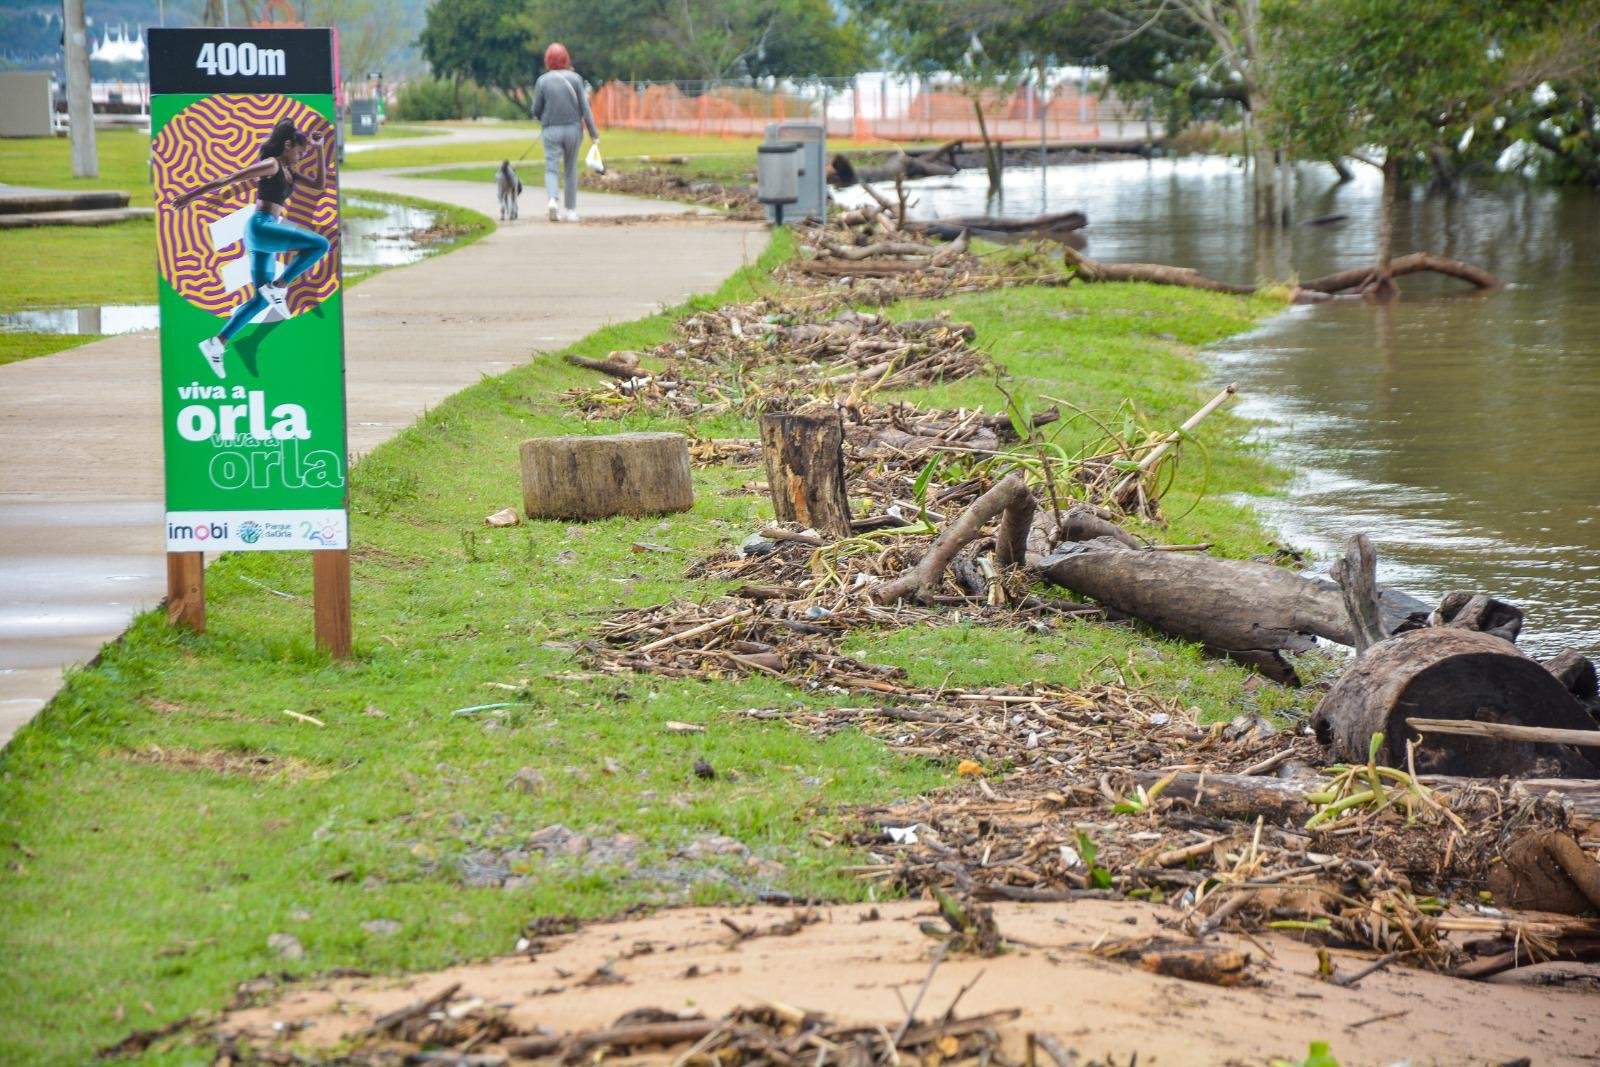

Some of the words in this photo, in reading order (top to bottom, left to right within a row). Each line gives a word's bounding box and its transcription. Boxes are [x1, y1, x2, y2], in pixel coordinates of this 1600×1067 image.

[196, 42, 286, 76] 400m
[178, 381, 227, 399] viva
[231, 385, 247, 399] a
[176, 390, 312, 441] orla
[209, 438, 345, 490] orla
[169, 522, 228, 541] imobi
[265, 523, 291, 531] Parque
